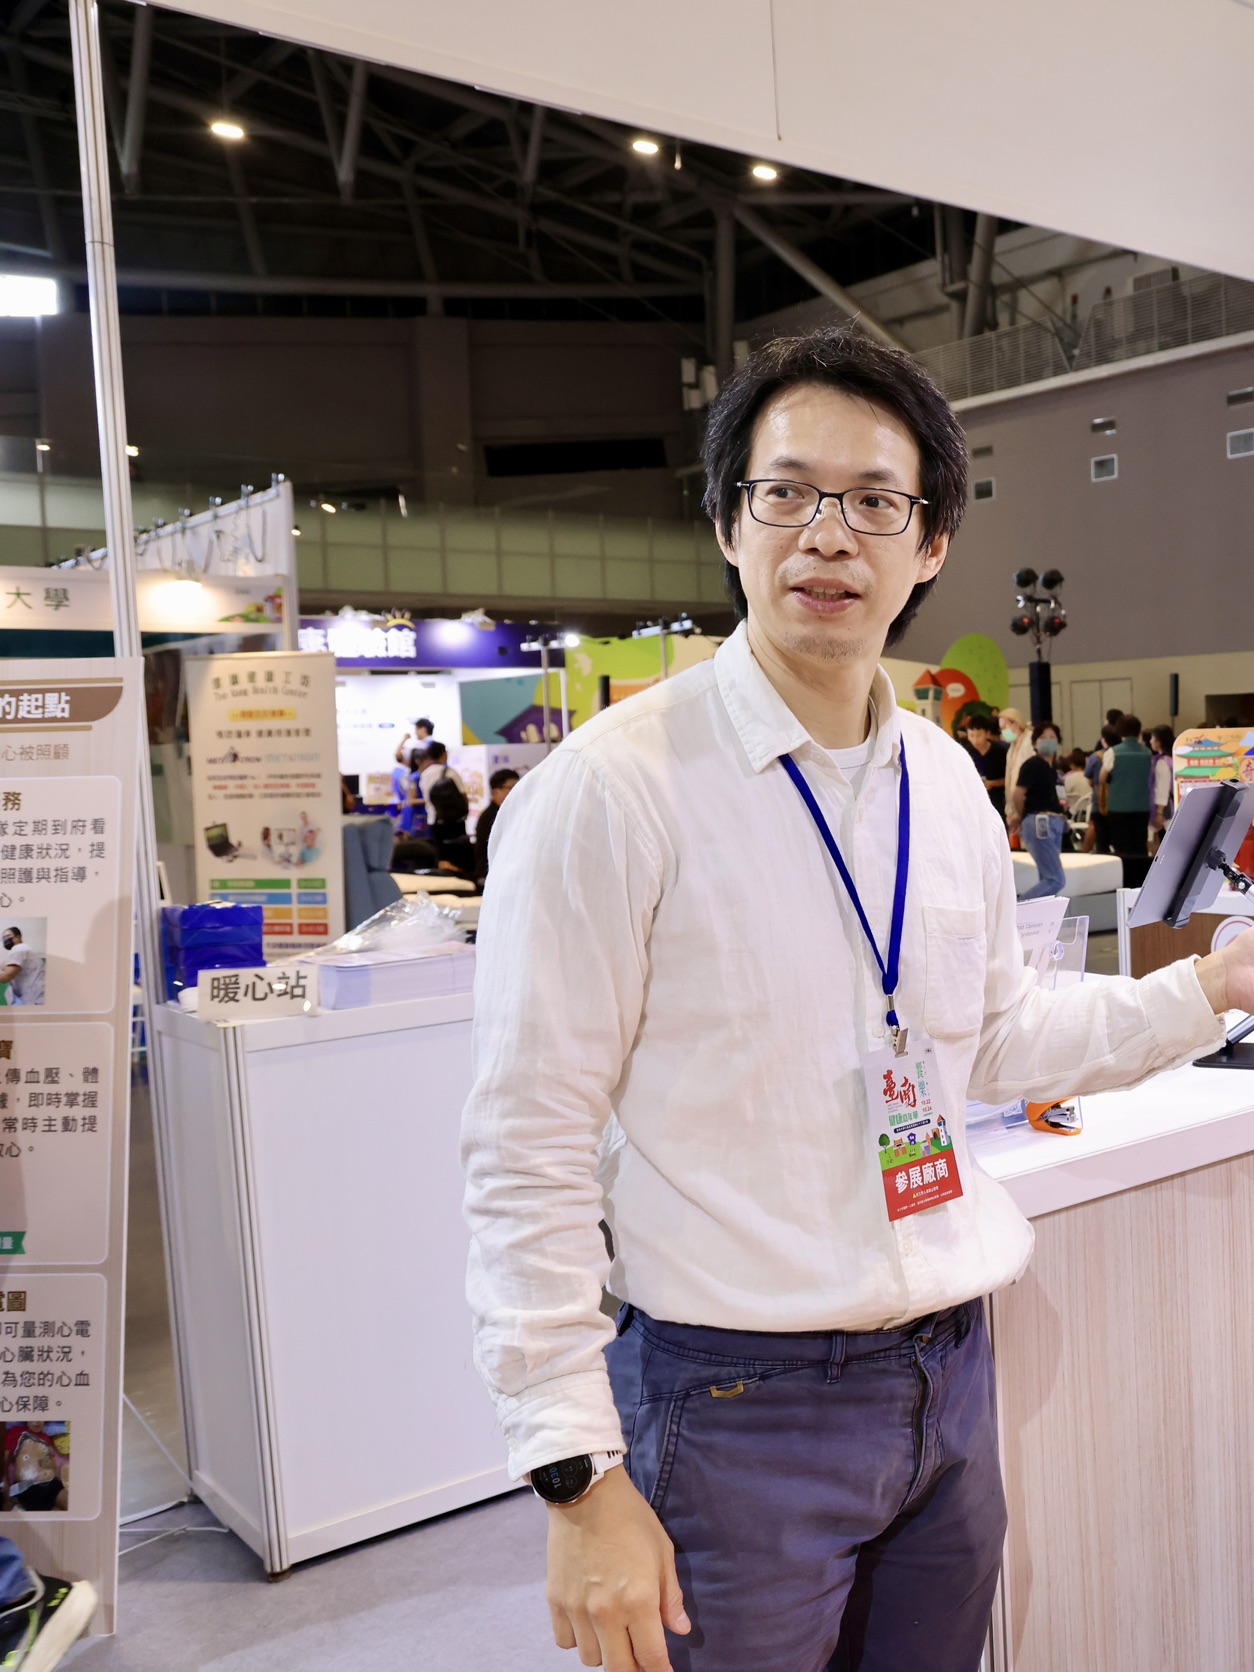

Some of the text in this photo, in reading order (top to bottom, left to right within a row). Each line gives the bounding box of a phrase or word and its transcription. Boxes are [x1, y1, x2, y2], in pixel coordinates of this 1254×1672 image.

[6, 586, 70, 611] 大學
[0, 792, 22, 811] 務
[211, 970, 308, 1004] 暖心站
[895, 1158, 949, 1194] 參展廠商
[0, 1320, 91, 1339] 可量測心電
